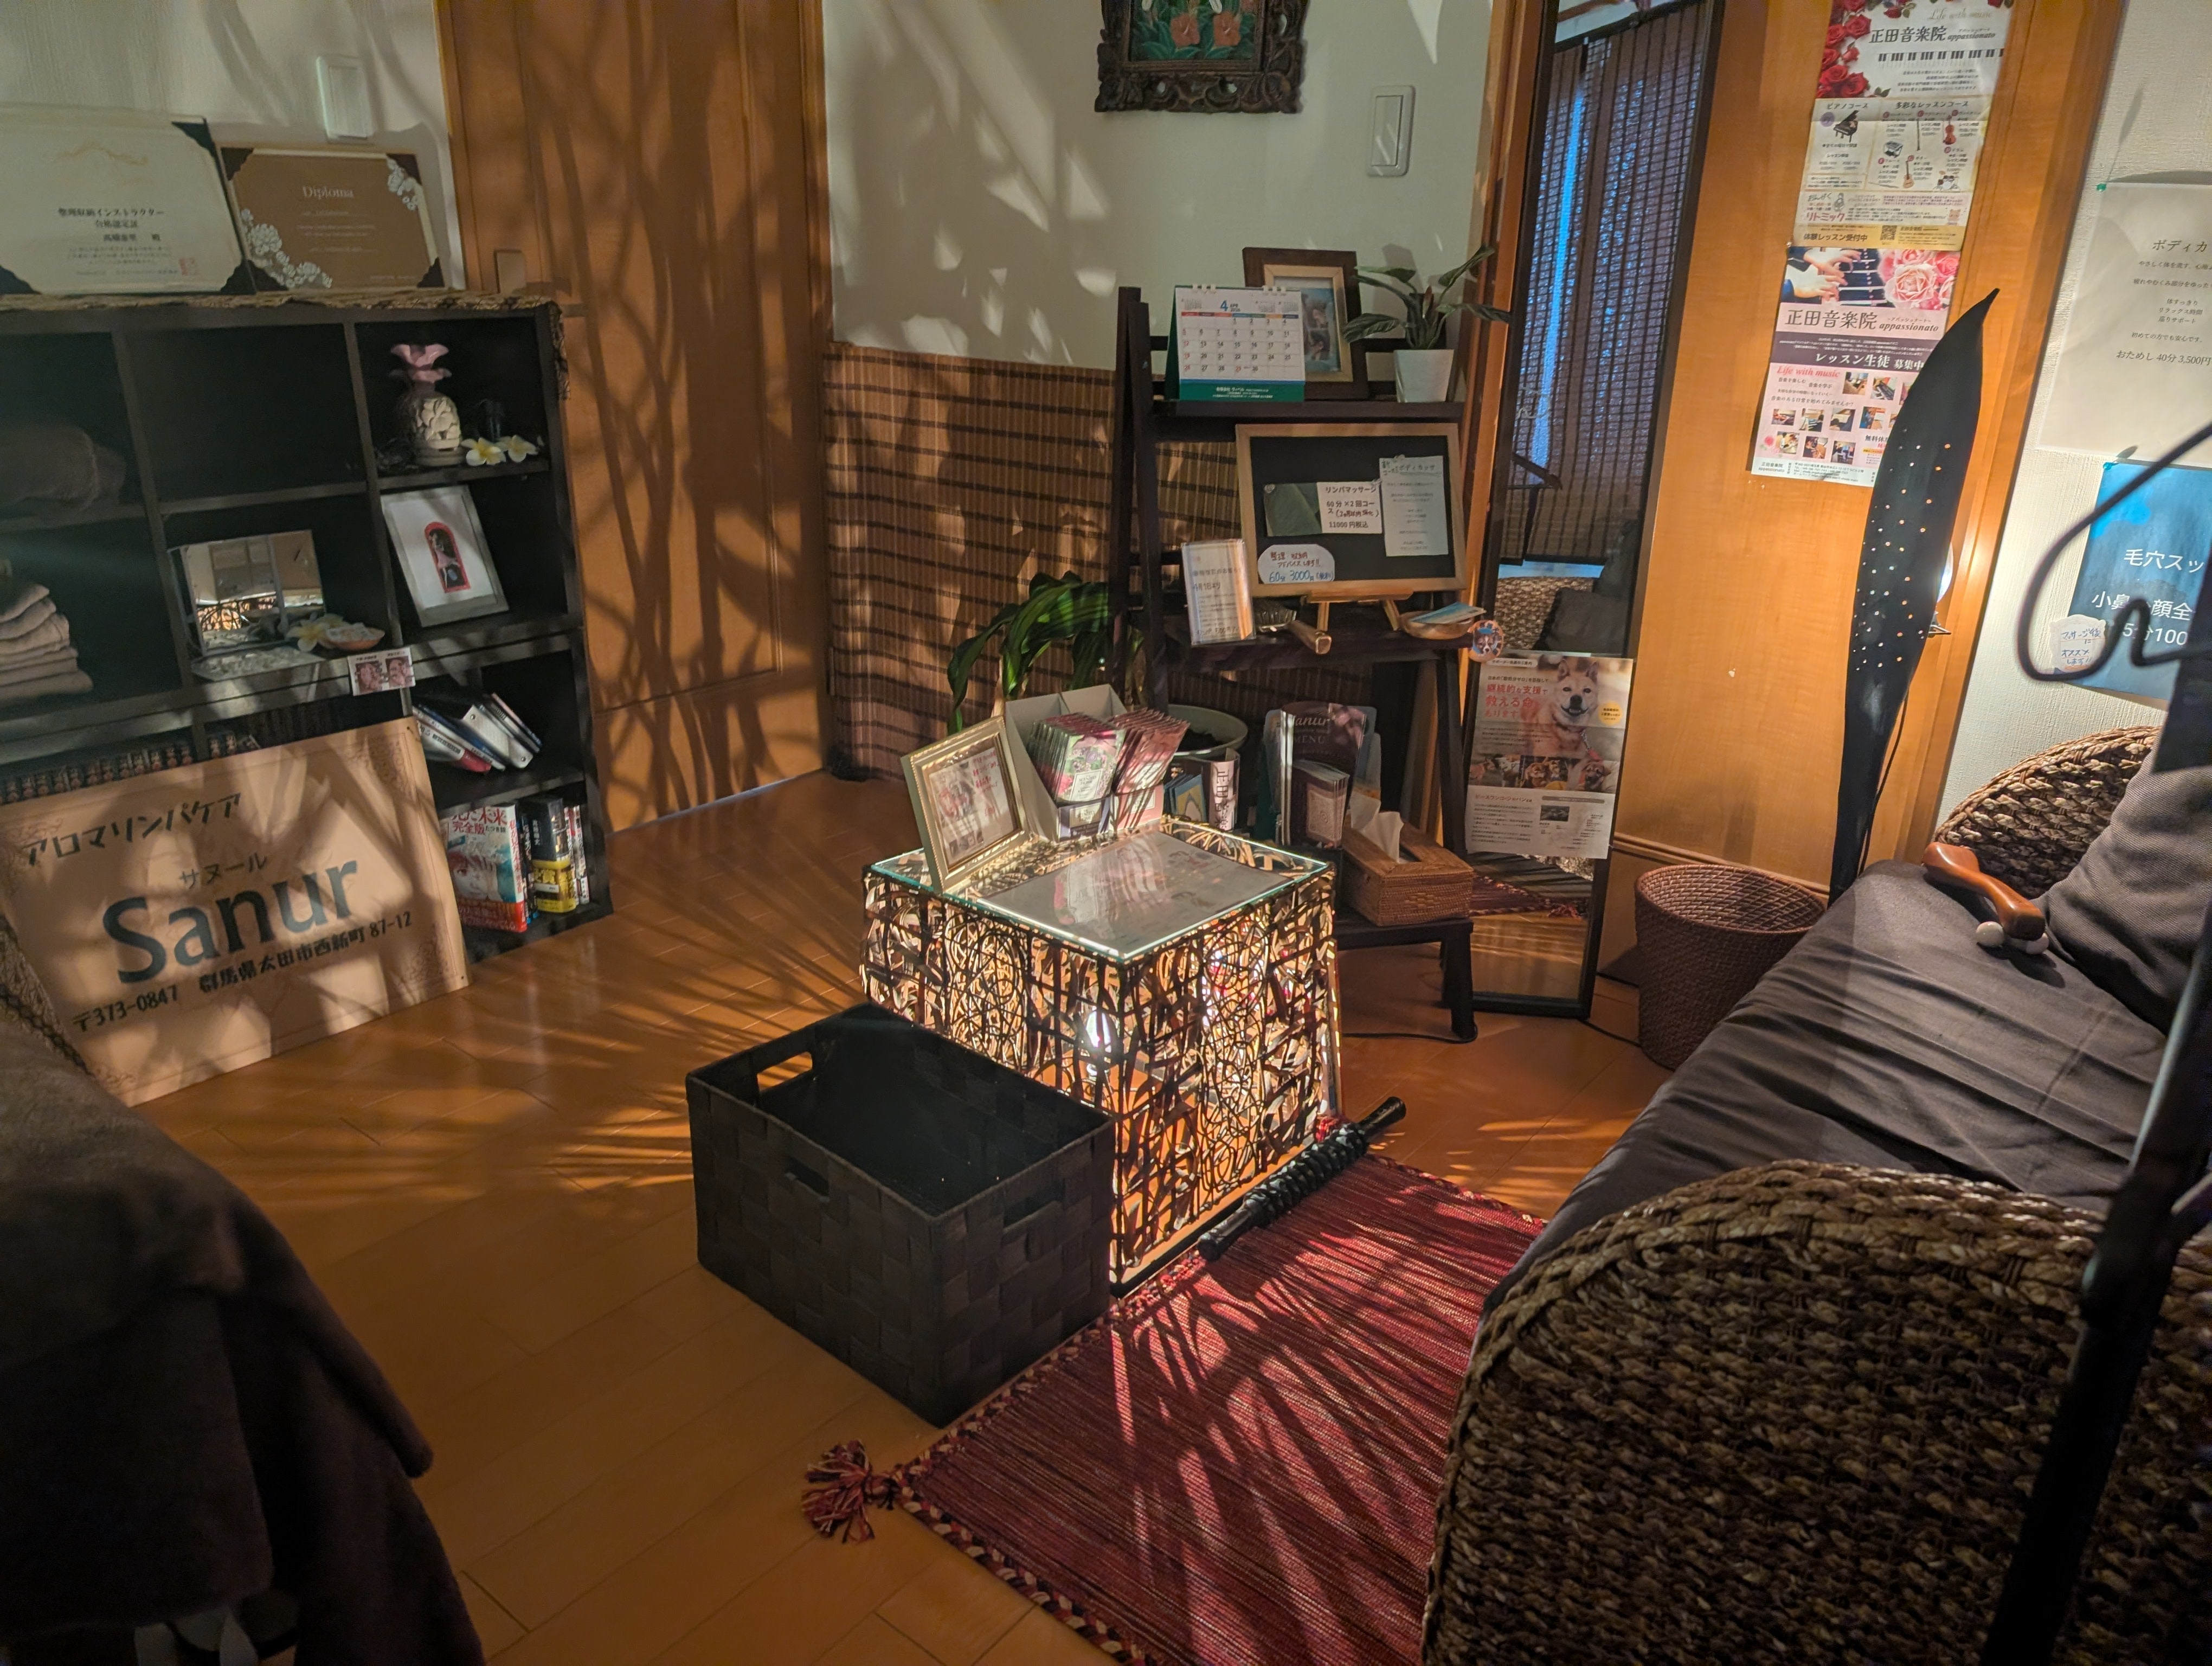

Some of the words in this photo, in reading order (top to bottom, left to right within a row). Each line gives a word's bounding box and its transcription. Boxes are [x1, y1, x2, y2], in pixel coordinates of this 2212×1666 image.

[1869, 25, 1947, 43] 正田音楽院
[1947, 33, 1996, 42] appassionato
[1895, 101, 1969, 109] 多彩なレッスンコース
[303, 186, 354, 200] Diploma
[1806, 212, 1845, 221] リトミック
[1804, 233, 1868, 242] 体験レッスン受付中
[2152, 239, 2208, 253] ボディカ
[1220, 300, 1228, 311] 4
[1785, 310, 1877, 330] 正田音楽院
[1879, 322, 1939, 332] appassionato
[1815, 353, 1891, 368] レッスン生徒
[1894, 358, 1925, 371] 募集中
[2117, 350, 2153, 362] おためし
[2157, 354, 2177, 363] 40分
[1777, 366, 1792, 375] Life
[1816, 370, 1840, 378] music
[2124, 548, 2204, 573] 毛穴スッ
[2092, 591, 2193, 621] 小鼻顔全
[2061, 627, 2101, 639] マッサージ後
[1295, 716, 1330, 726] anur
[21, 792, 241, 866] アロマリンパケア
[453, 821, 485, 835] 完全版
[178, 852, 267, 889] サヌール
[102, 861, 358, 984] Sanur
[73, 984, 178, 1033] 〒373-0847
[200, 927, 366, 994] 群馬県太田市西新町
[370, 912, 412, 939] 87-12
